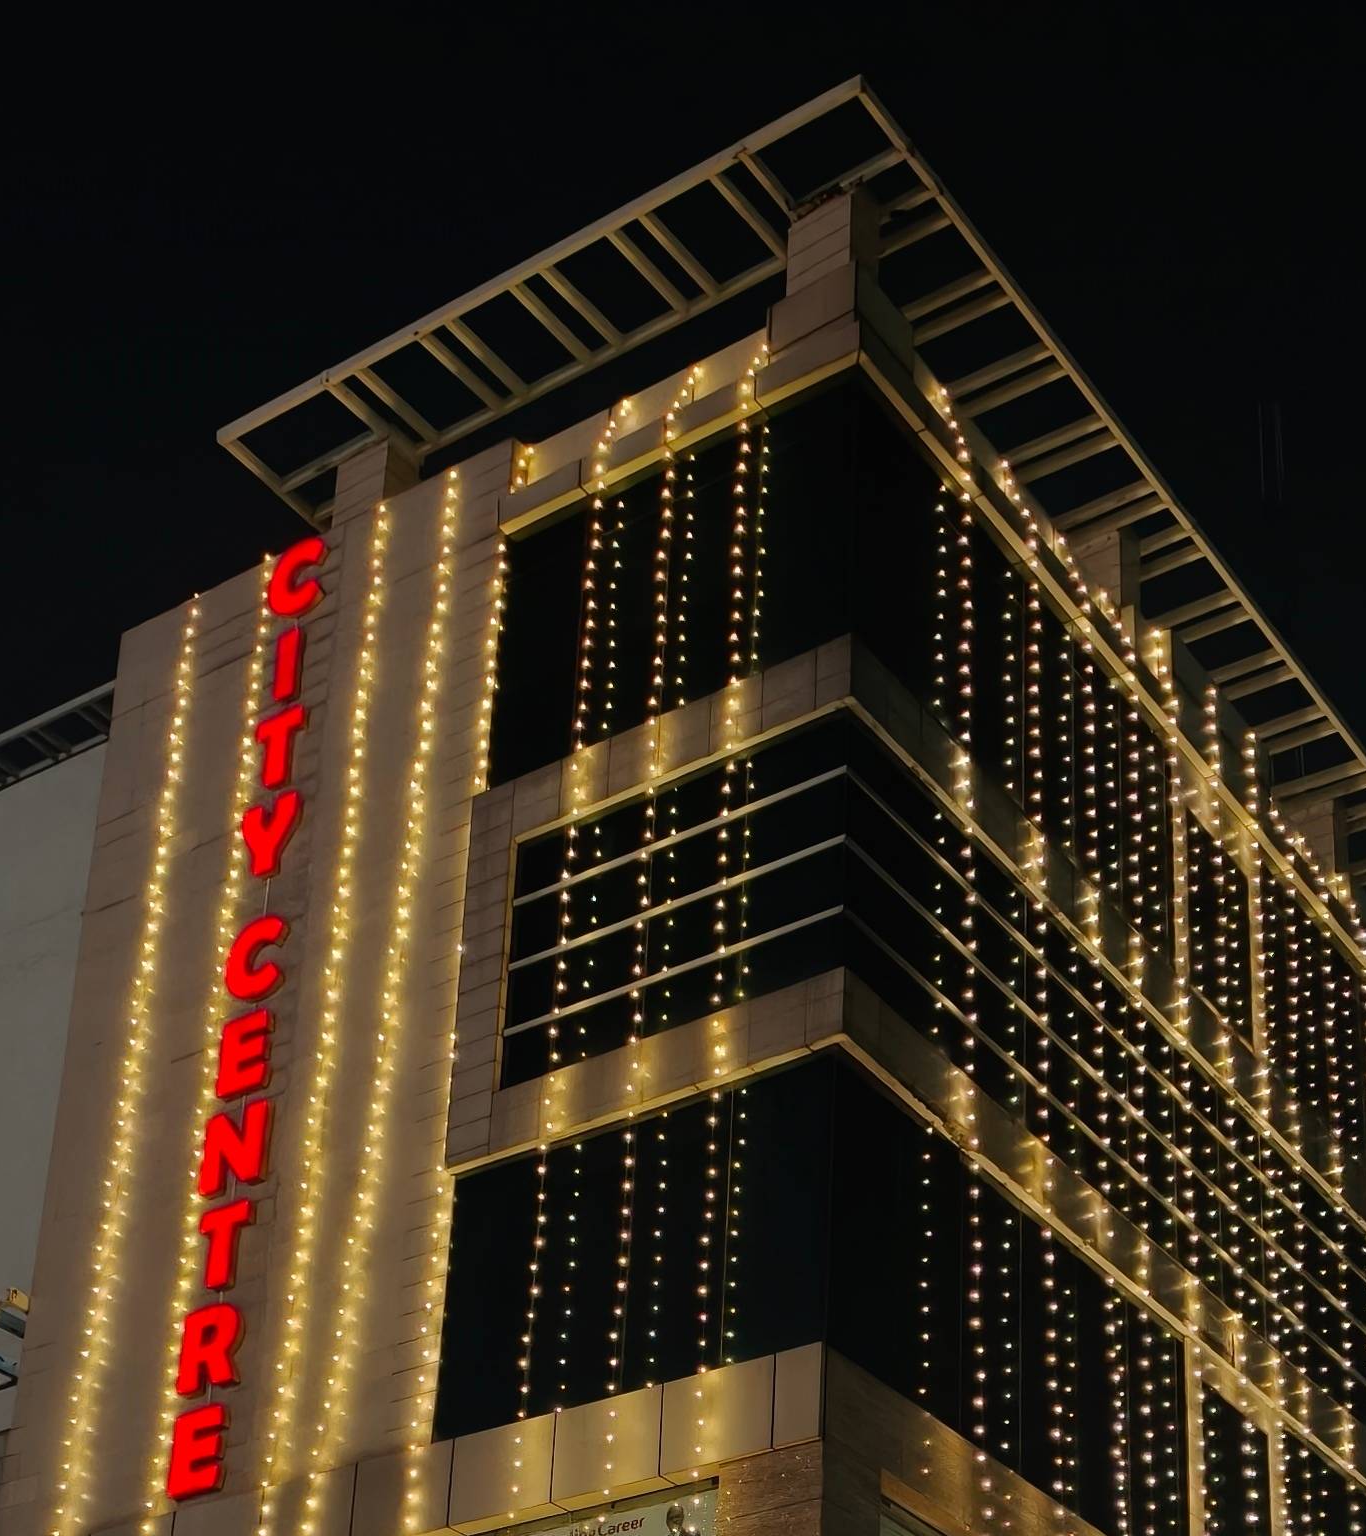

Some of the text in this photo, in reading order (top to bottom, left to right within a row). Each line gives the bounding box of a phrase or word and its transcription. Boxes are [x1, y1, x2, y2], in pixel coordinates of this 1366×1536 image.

[166, 536, 328, 1500] CITY CENTRE
[598, 1517, 645, 1536] Career
